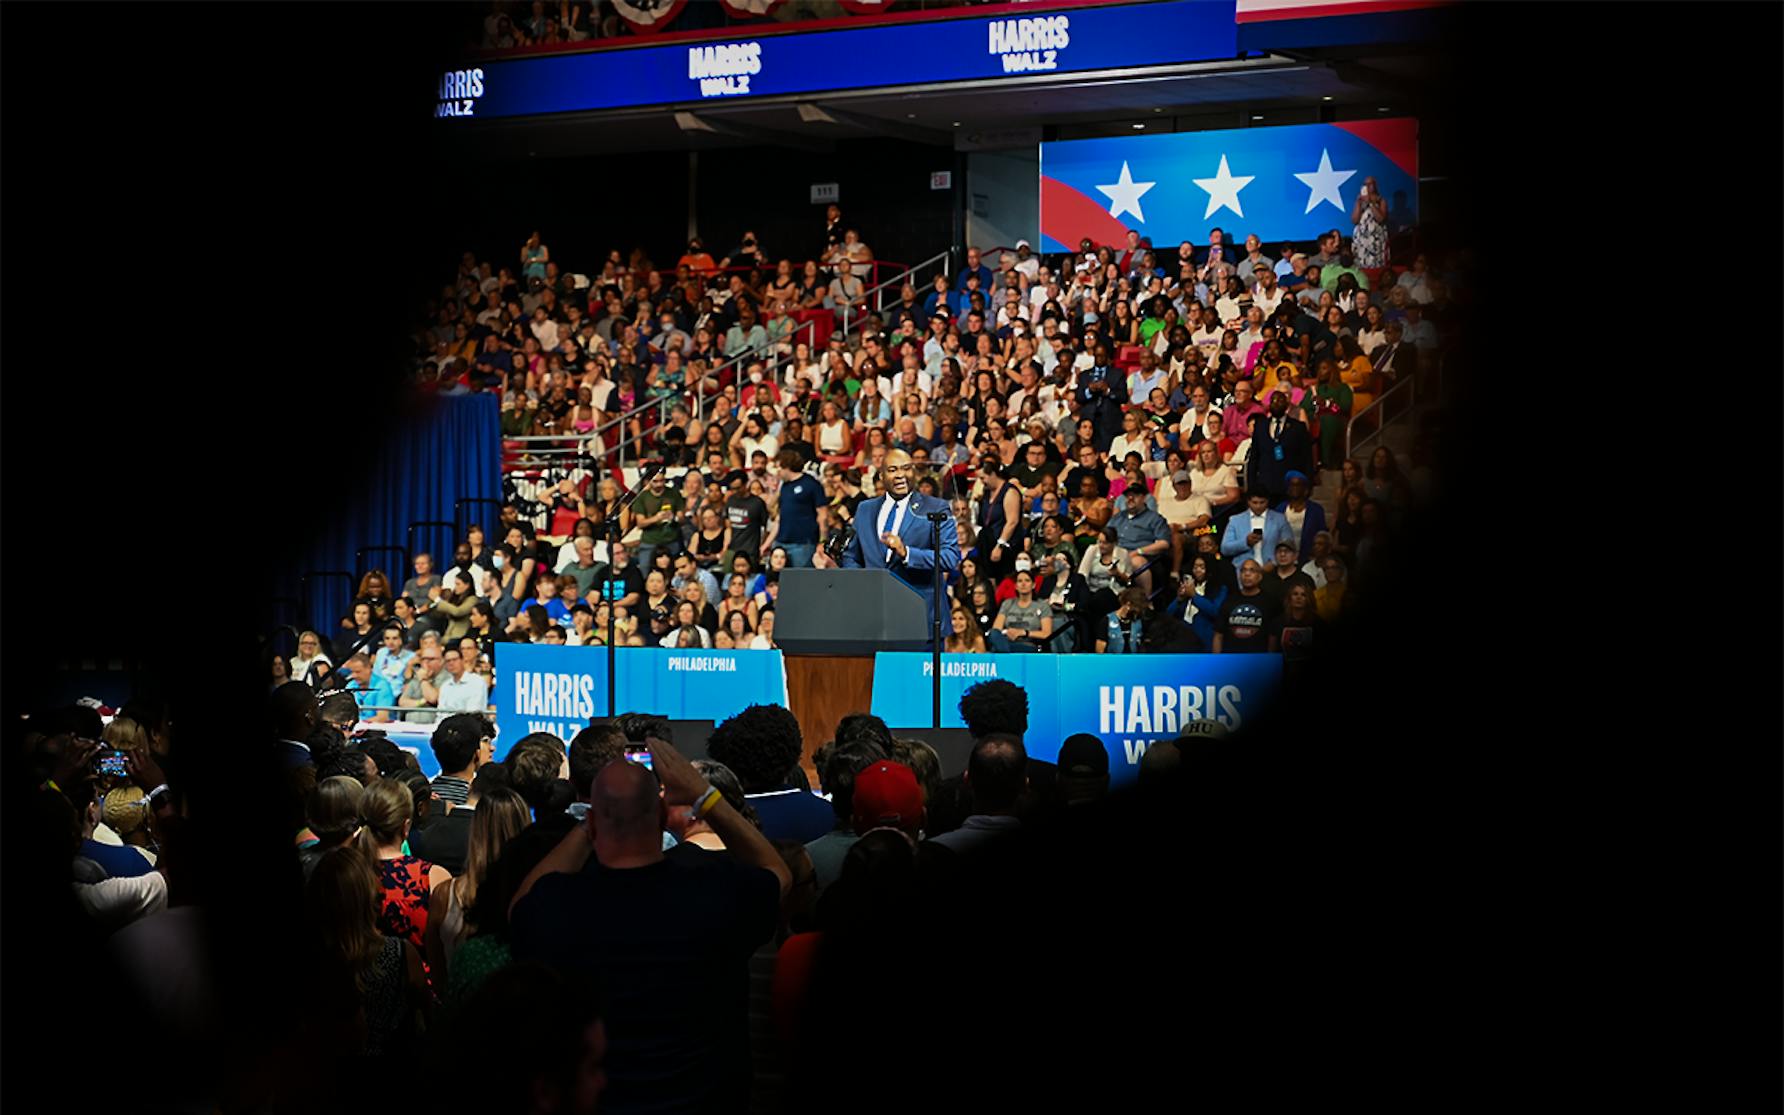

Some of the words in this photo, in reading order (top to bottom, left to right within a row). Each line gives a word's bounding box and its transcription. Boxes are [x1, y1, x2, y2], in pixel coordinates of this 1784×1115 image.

[988, 15, 1069, 54] HARRIS
[1002, 50, 1057, 72] WALZ
[437, 68, 483, 99] ARRIS
[668, 656, 736, 671] PHILADELPHIA
[515, 671, 594, 719] HARRIS
[1100, 685, 1242, 733] HARRIS
[1188, 722, 1213, 734] HU
